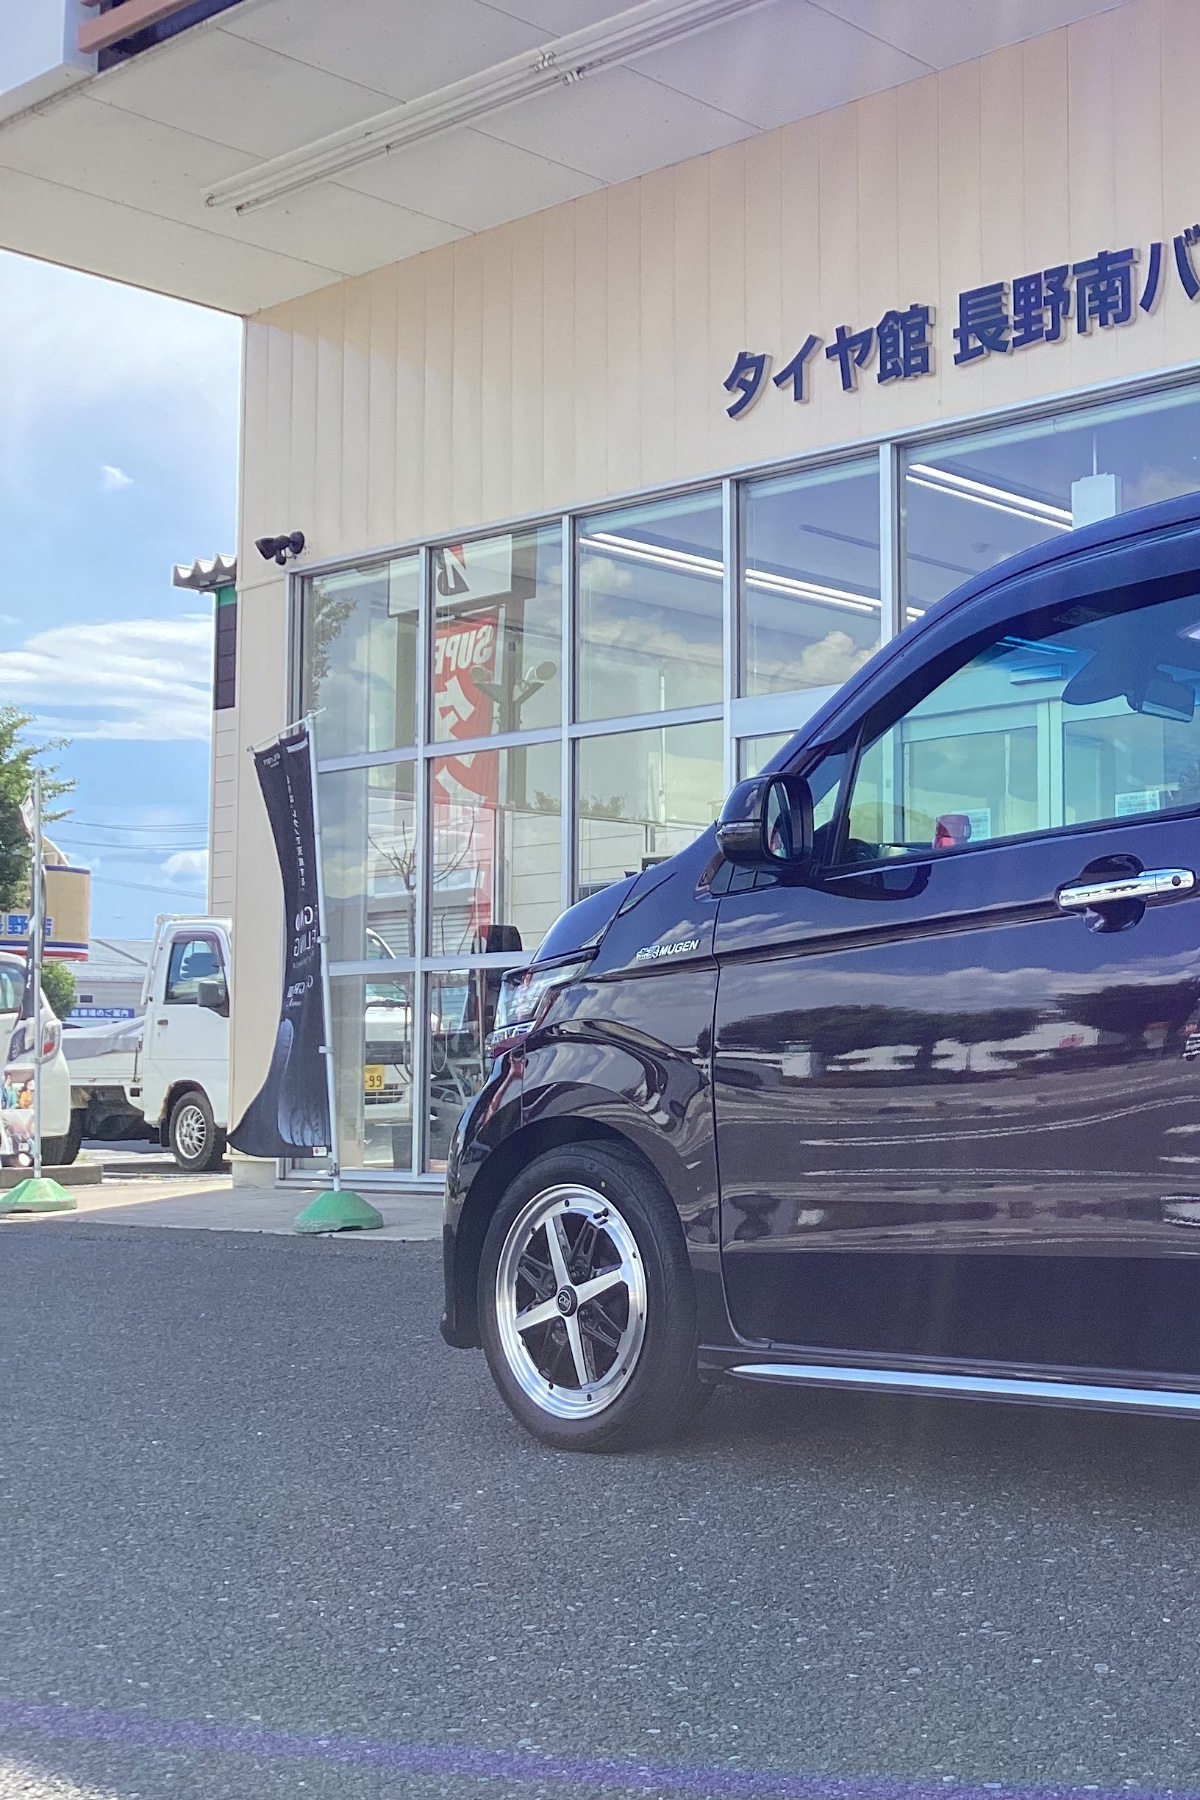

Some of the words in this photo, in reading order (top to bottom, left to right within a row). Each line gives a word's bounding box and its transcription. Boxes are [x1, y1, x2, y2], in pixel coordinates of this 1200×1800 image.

[723, 302, 935, 420] タイヤ館
[659, 939, 700, 957] MUGEN
